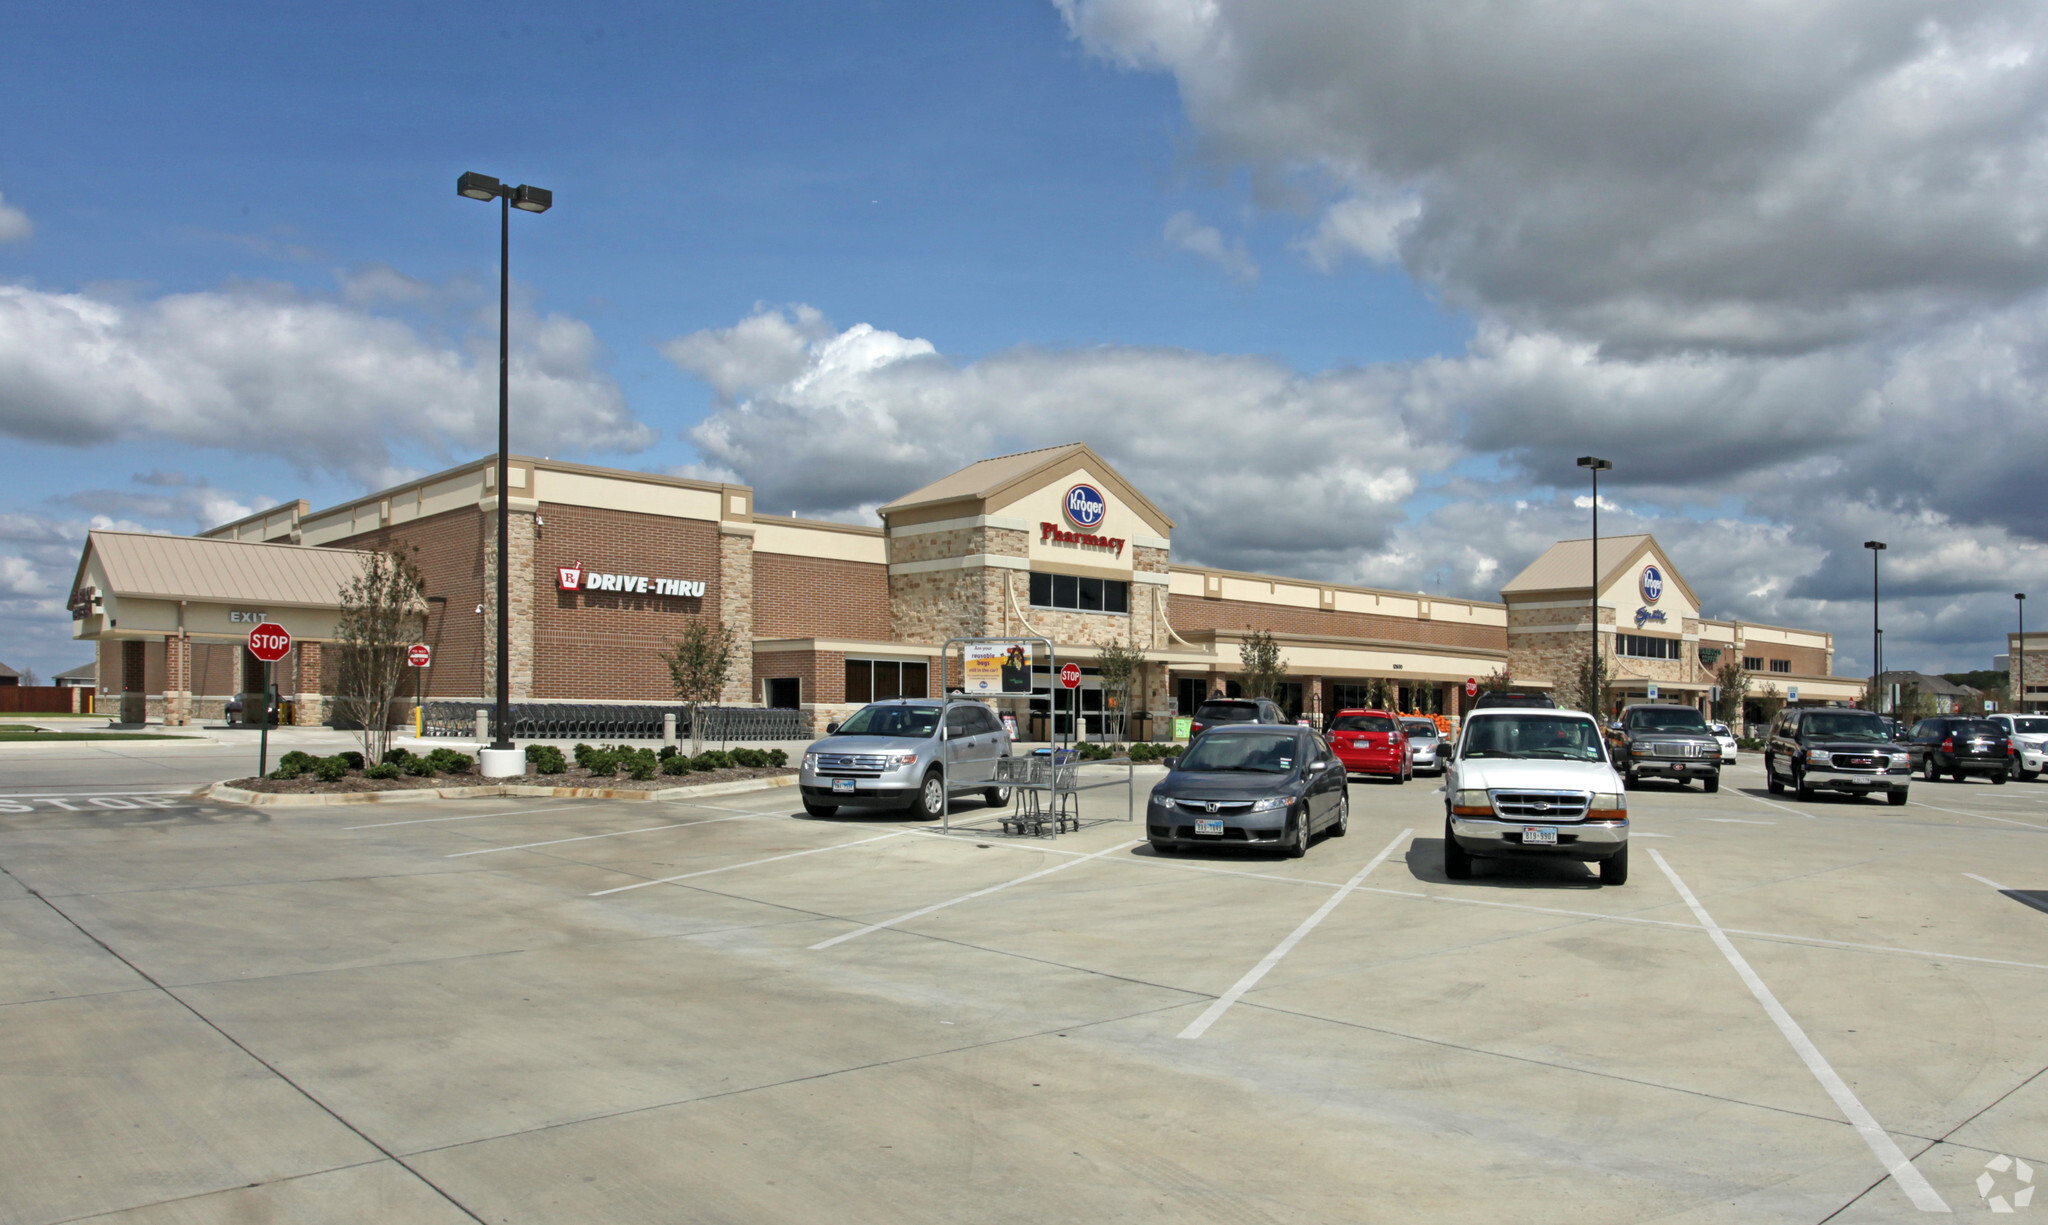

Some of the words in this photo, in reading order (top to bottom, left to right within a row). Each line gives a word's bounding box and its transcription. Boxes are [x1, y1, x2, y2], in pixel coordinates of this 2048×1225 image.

[1070, 489, 1103, 522] Kroger
[1040, 522, 1125, 555] Pharmacy
[586, 572, 706, 597] DRIVE-THRU
[1643, 570, 1662, 598] Kroger
[230, 611, 267, 622] EXIT
[251, 634, 288, 650] STOP
[1062, 671, 1080, 682] STOP
[0, 797, 178, 812] STOP
